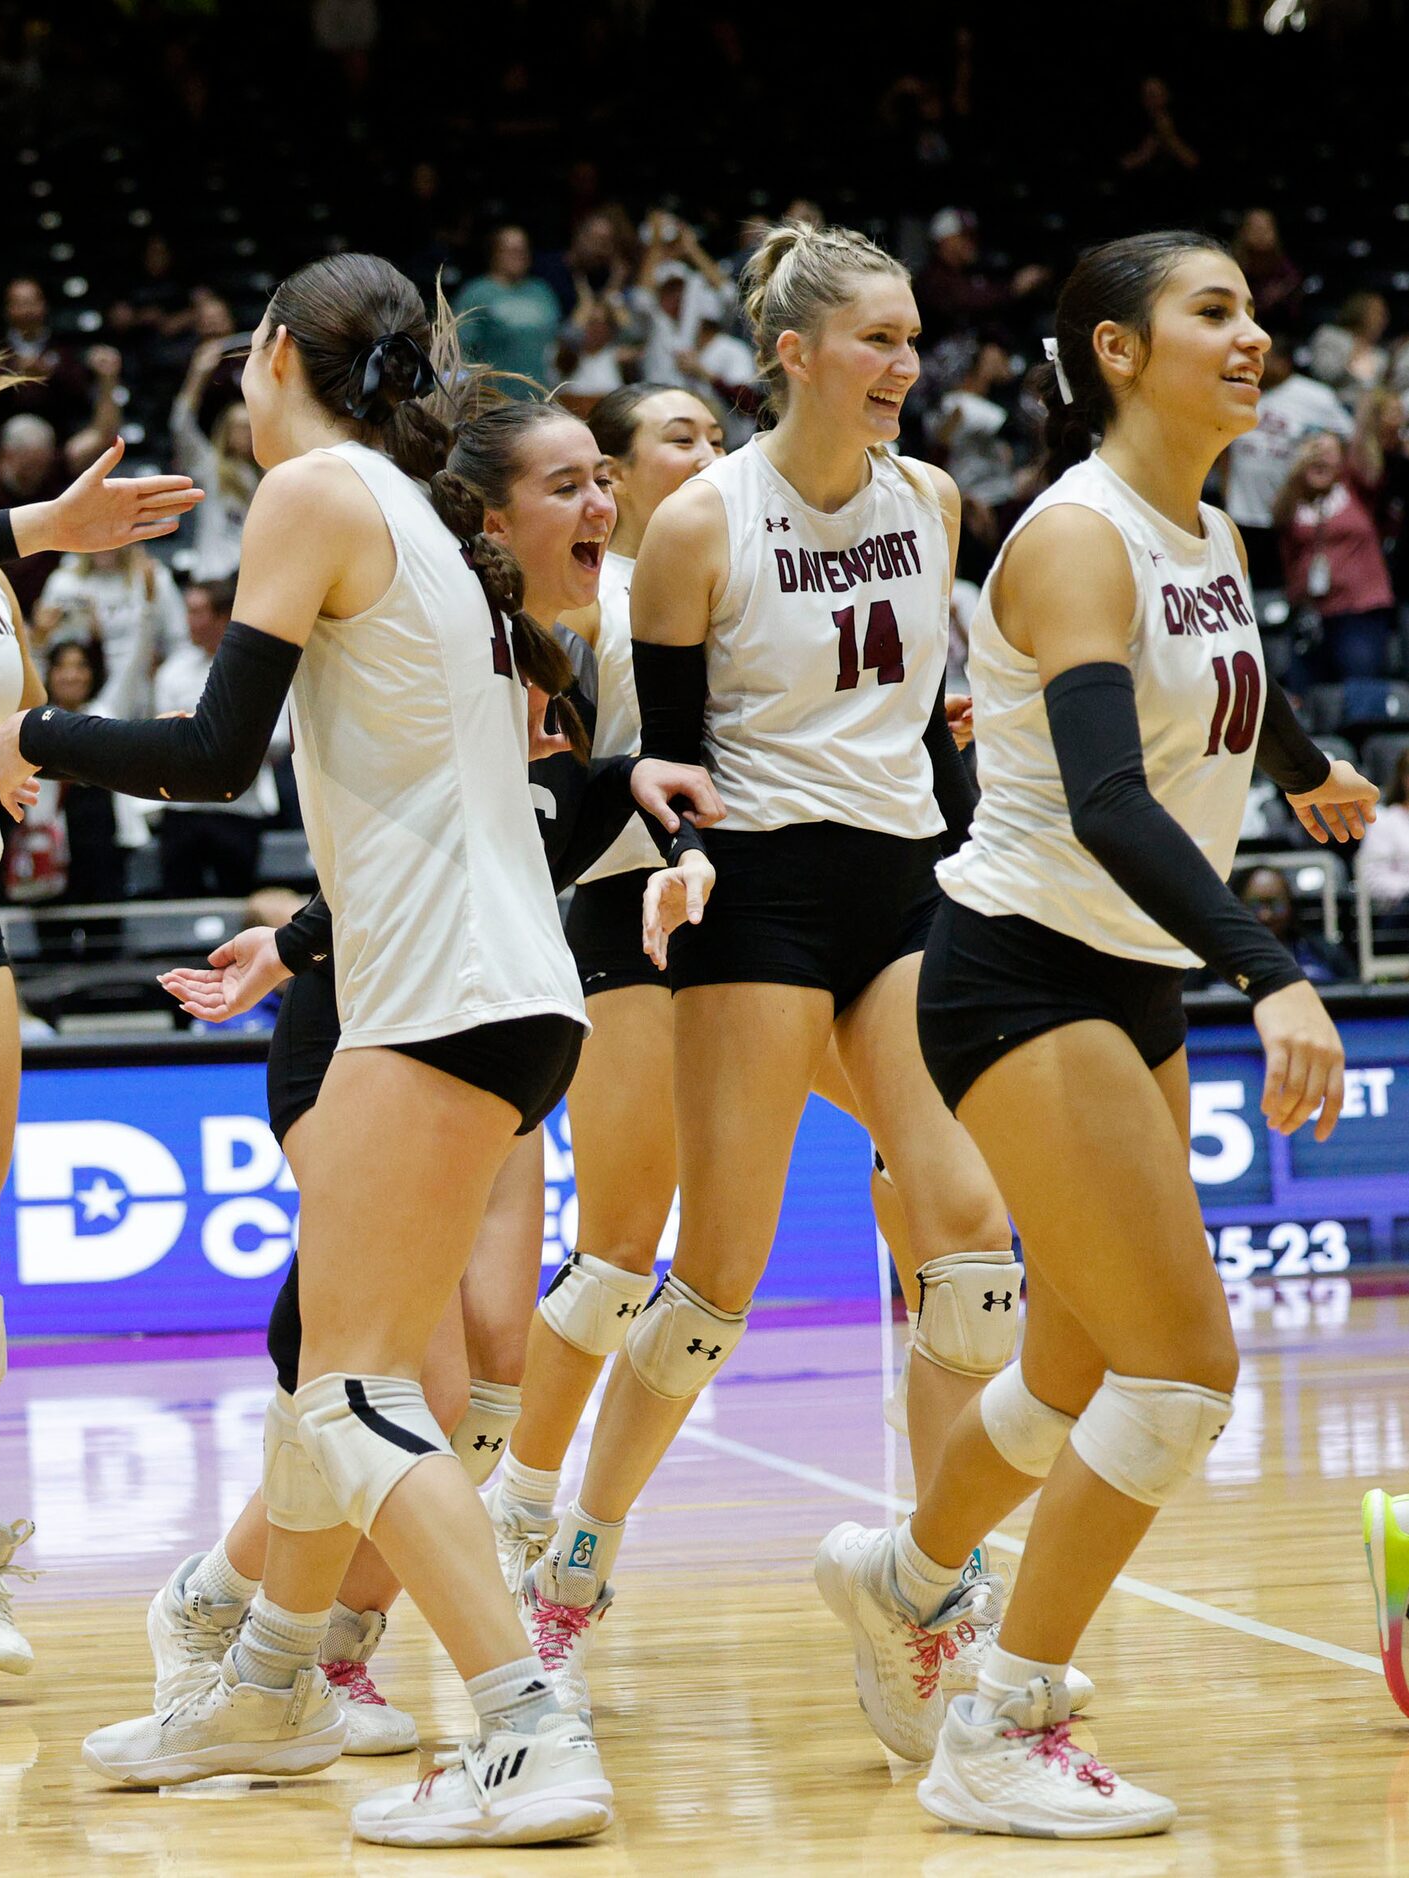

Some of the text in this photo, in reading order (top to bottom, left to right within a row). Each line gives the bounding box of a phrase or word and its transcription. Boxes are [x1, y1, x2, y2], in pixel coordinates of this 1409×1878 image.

[774, 530, 922, 593] DAVENPORT
[831, 599, 905, 692] 14
[1202, 651, 1261, 757] 10
[1309, 1068, 1395, 1121] ET
